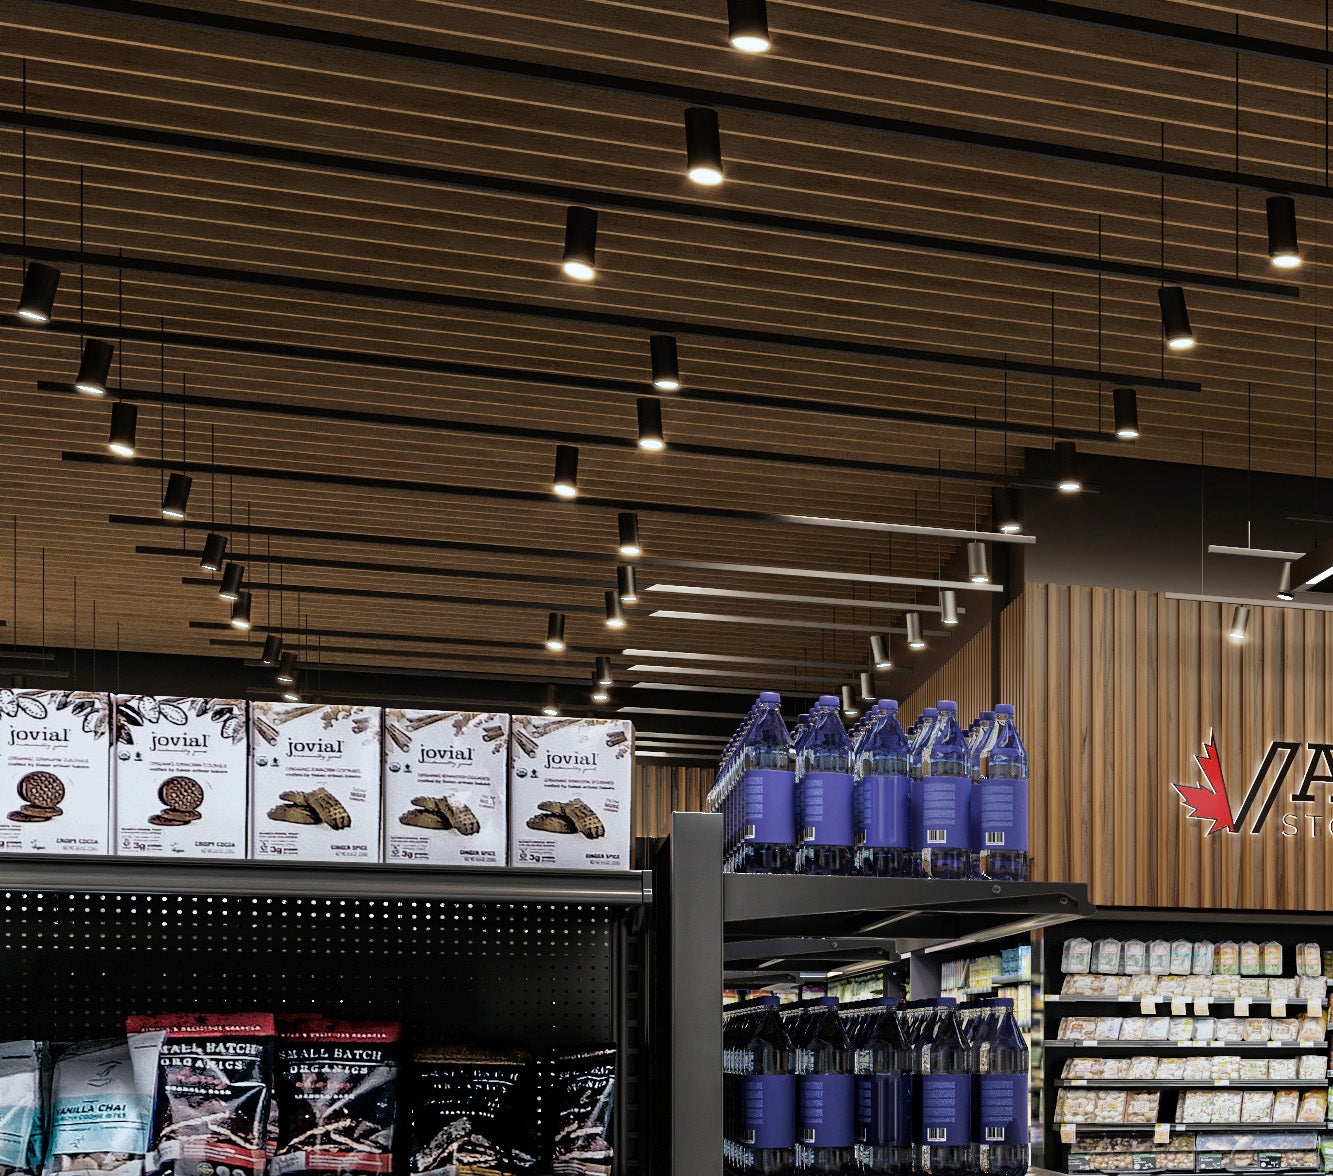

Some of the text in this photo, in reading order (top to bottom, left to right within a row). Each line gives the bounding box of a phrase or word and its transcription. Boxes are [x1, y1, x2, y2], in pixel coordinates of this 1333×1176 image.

[8, 726, 70, 746] jovial
[151, 732, 208, 752] jovial
[286, 738, 342, 757] jovial
[418, 744, 473, 763] jovial
[545, 750, 597, 769] jovial
[206, 1042, 257, 1055] BATCH
[334, 1048, 382, 1060] BATCH
[160, 1058, 243, 1070] ORGANICS
[290, 1065, 369, 1075] ORGANICS
[98, 1104, 126, 1113] CHAI
